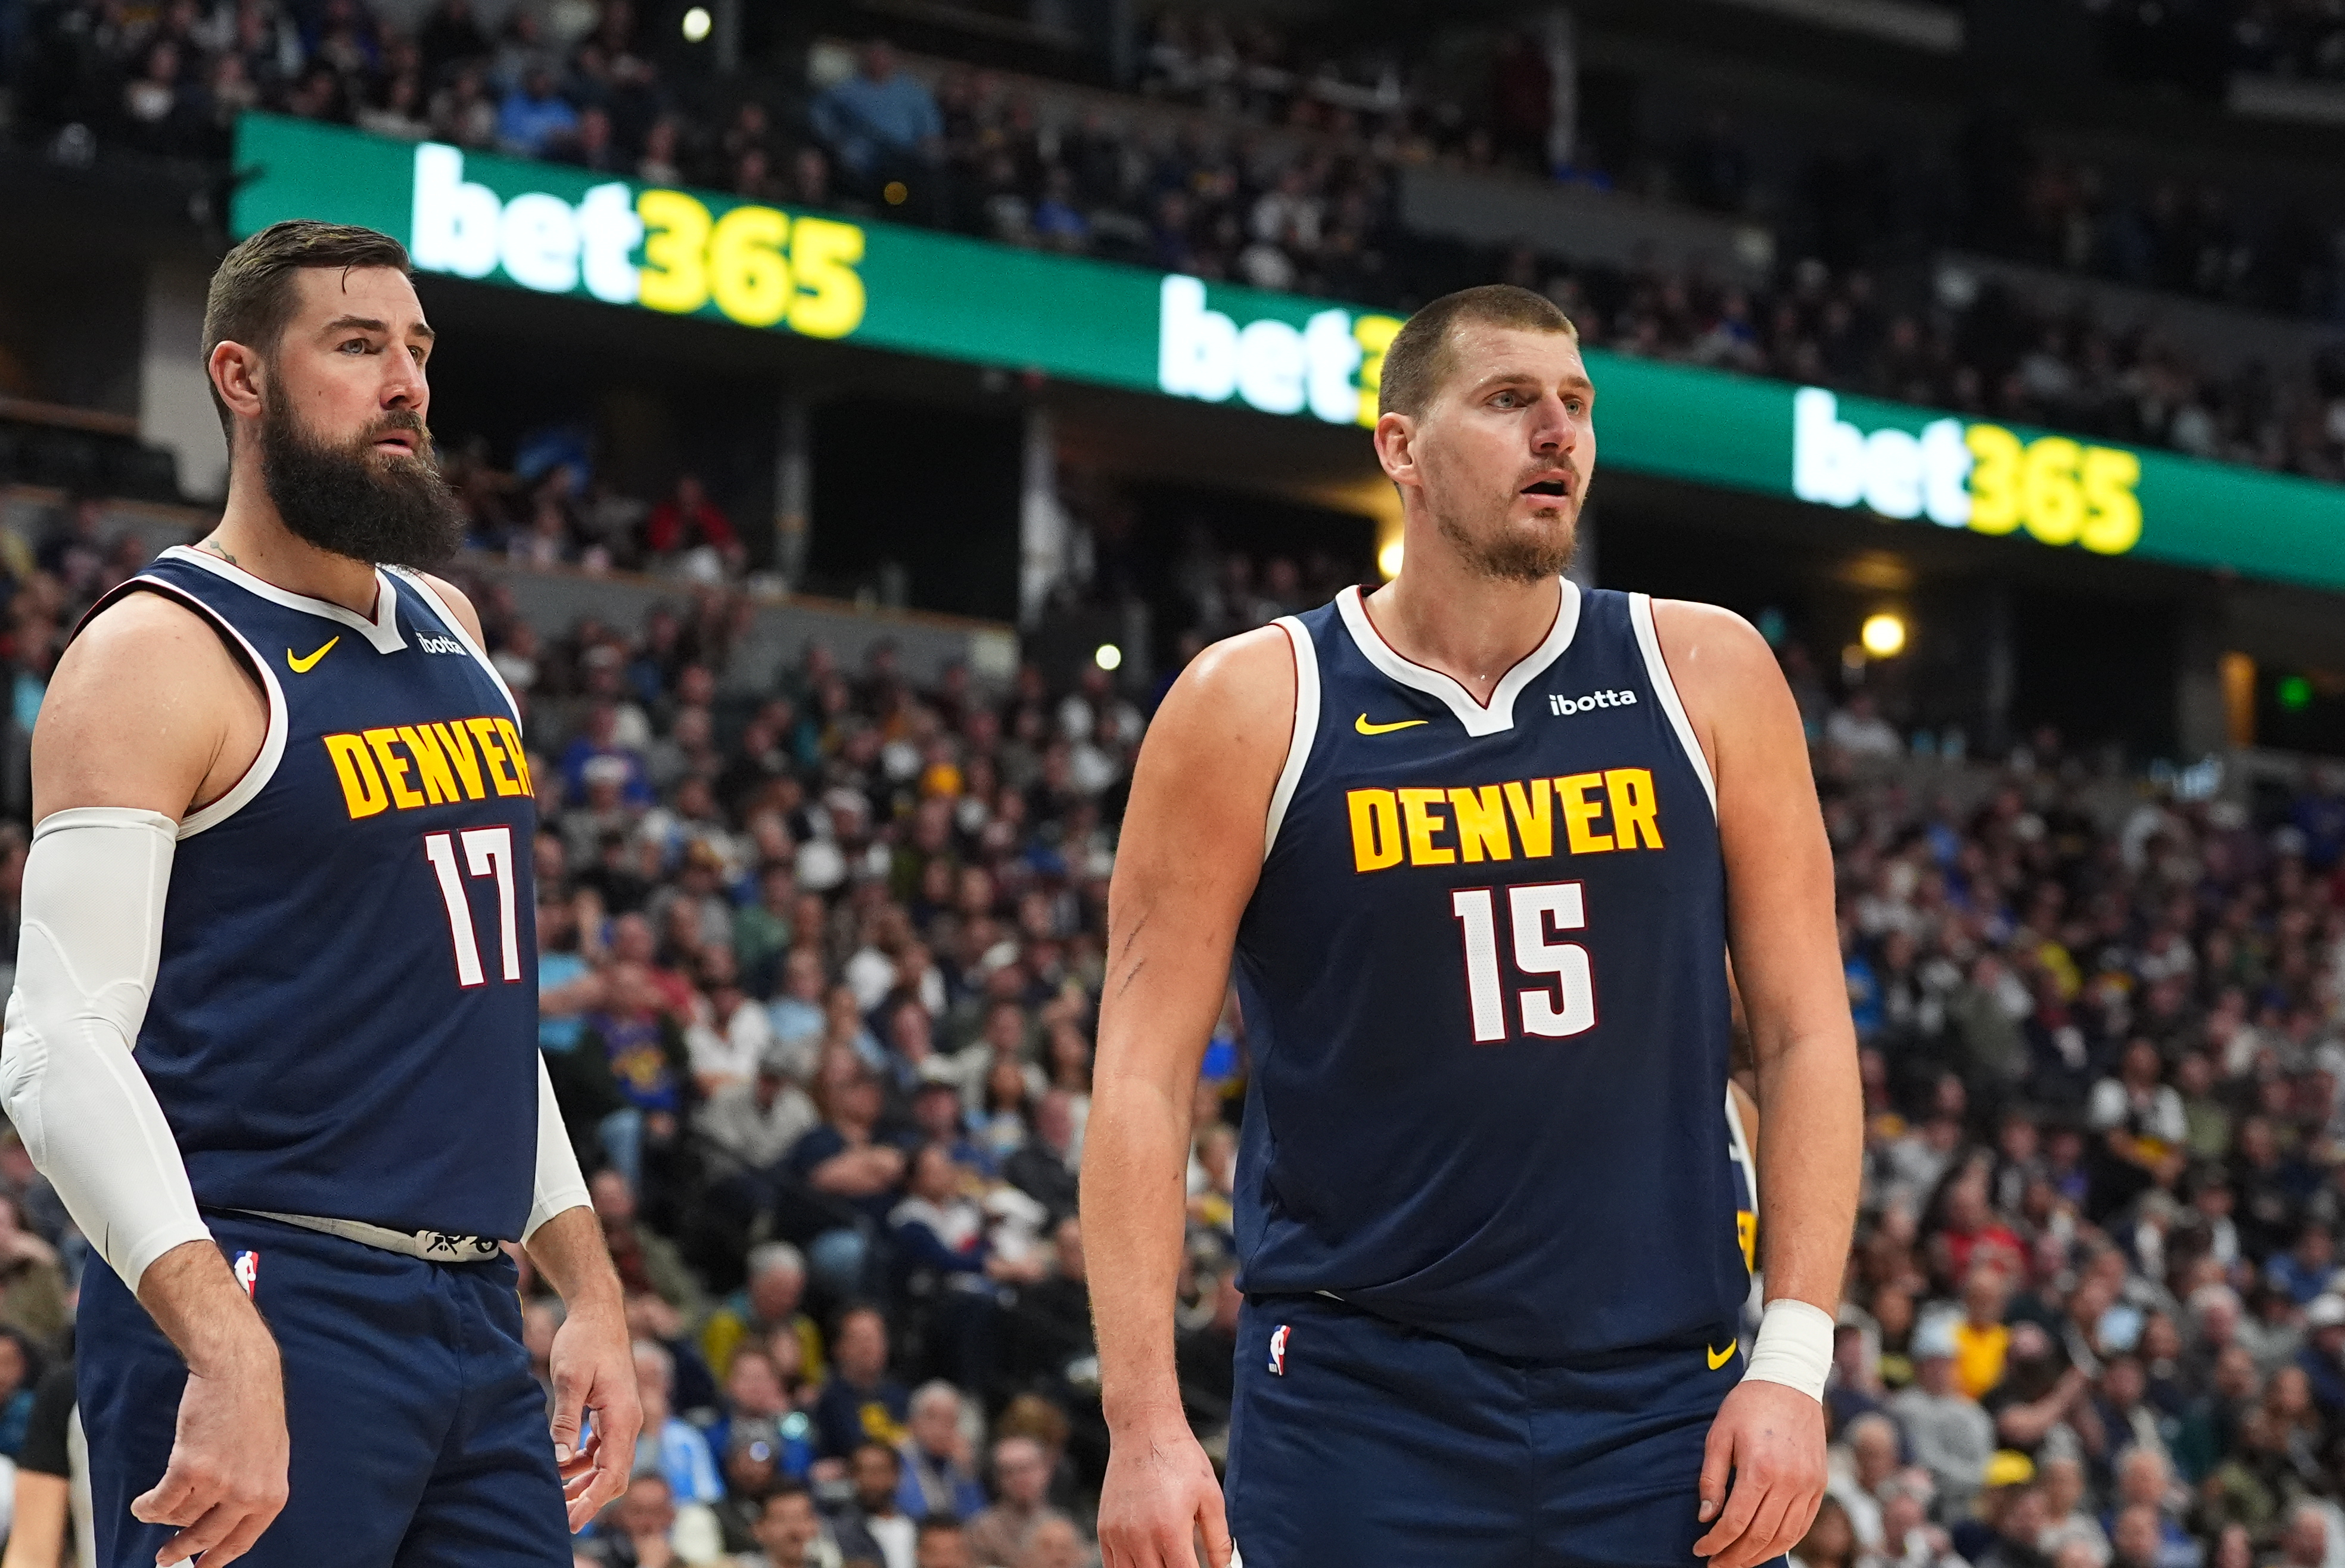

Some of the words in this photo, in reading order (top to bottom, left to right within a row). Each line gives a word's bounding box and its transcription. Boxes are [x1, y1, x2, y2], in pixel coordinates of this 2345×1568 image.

[410, 142, 866, 338] bet365
[1793, 387, 2142, 554] bet365
[415, 631, 466, 655] ibotta
[1549, 689, 1638, 715] ibotta
[324, 717, 535, 820] DENVER
[1346, 767, 1665, 873] DENVER
[424, 825, 522, 989] 17
[1450, 879, 1598, 1044] 15
